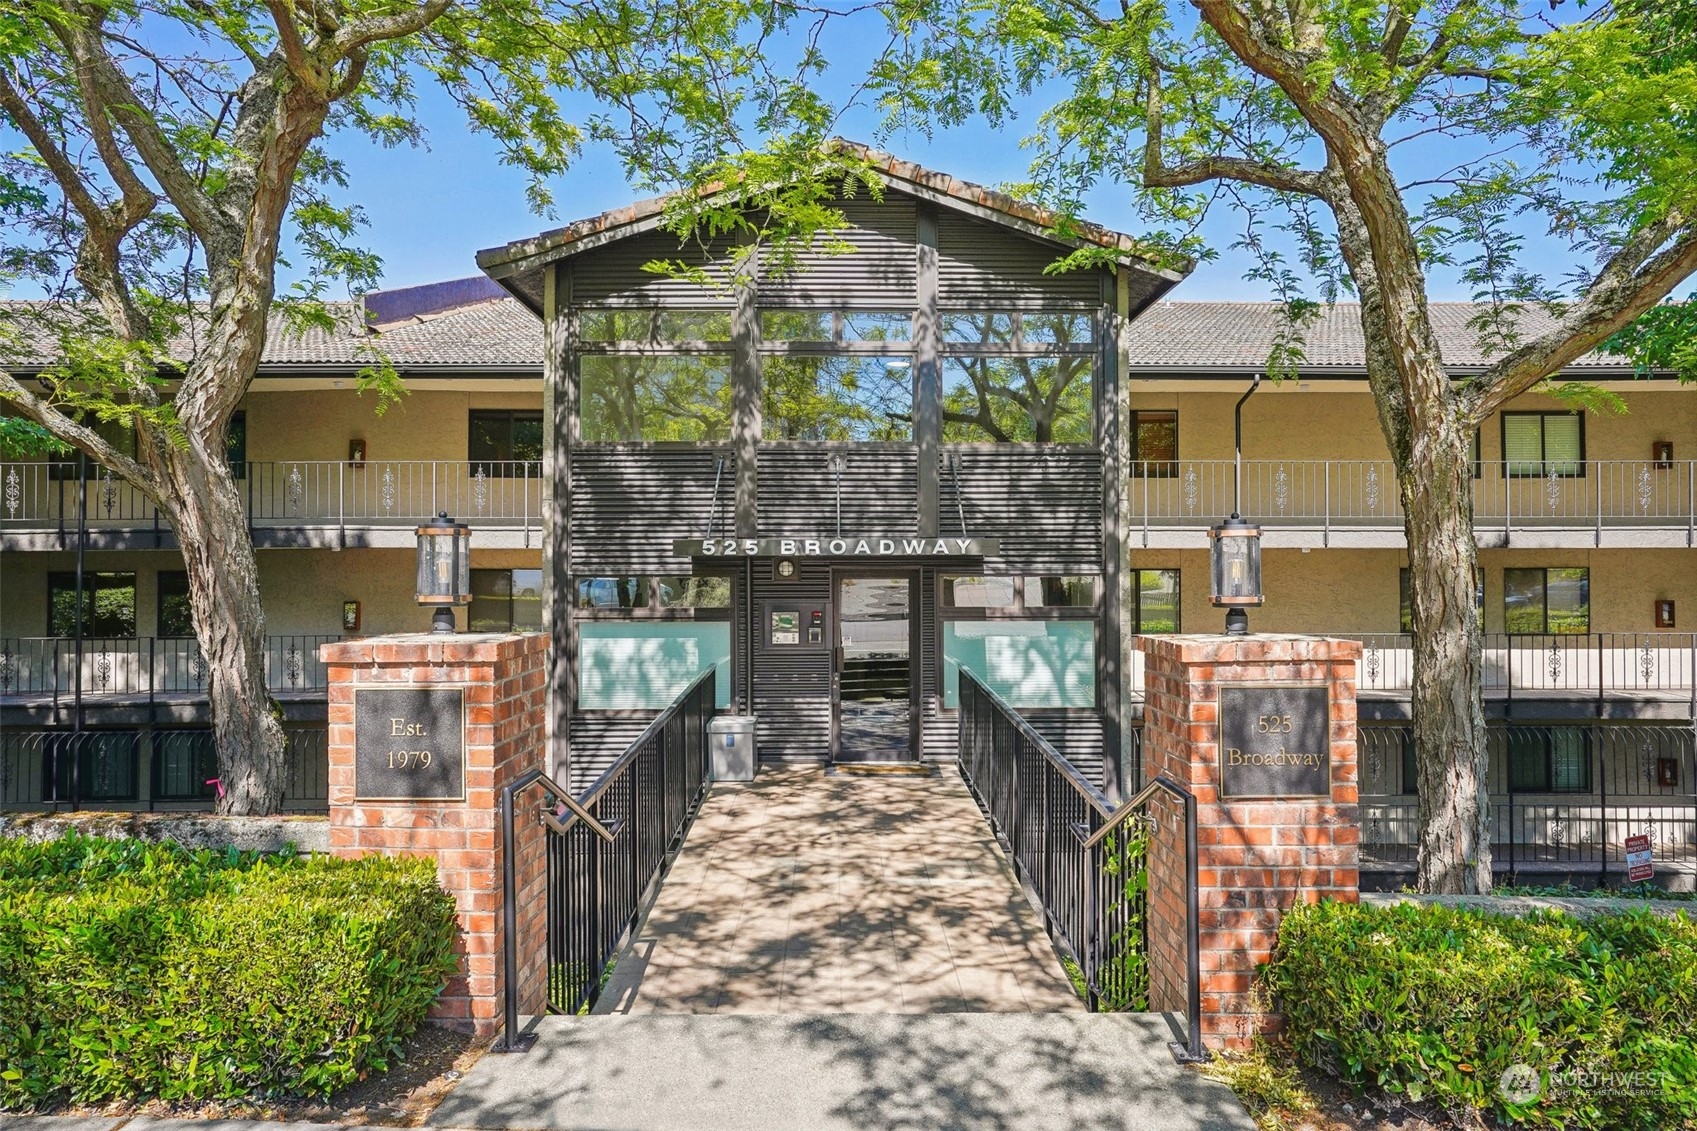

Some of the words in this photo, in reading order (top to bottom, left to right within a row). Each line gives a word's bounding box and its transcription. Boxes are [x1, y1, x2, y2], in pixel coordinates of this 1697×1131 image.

[702, 539, 759, 555] 525
[780, 539, 972, 555] BROADWAY
[390, 718, 427, 736] Est.
[1258, 715, 1293, 733] 525
[386, 750, 432, 769] 1979
[1226, 747, 1325, 771] Broadway
[1627, 844, 1648, 853] PROPERTY
